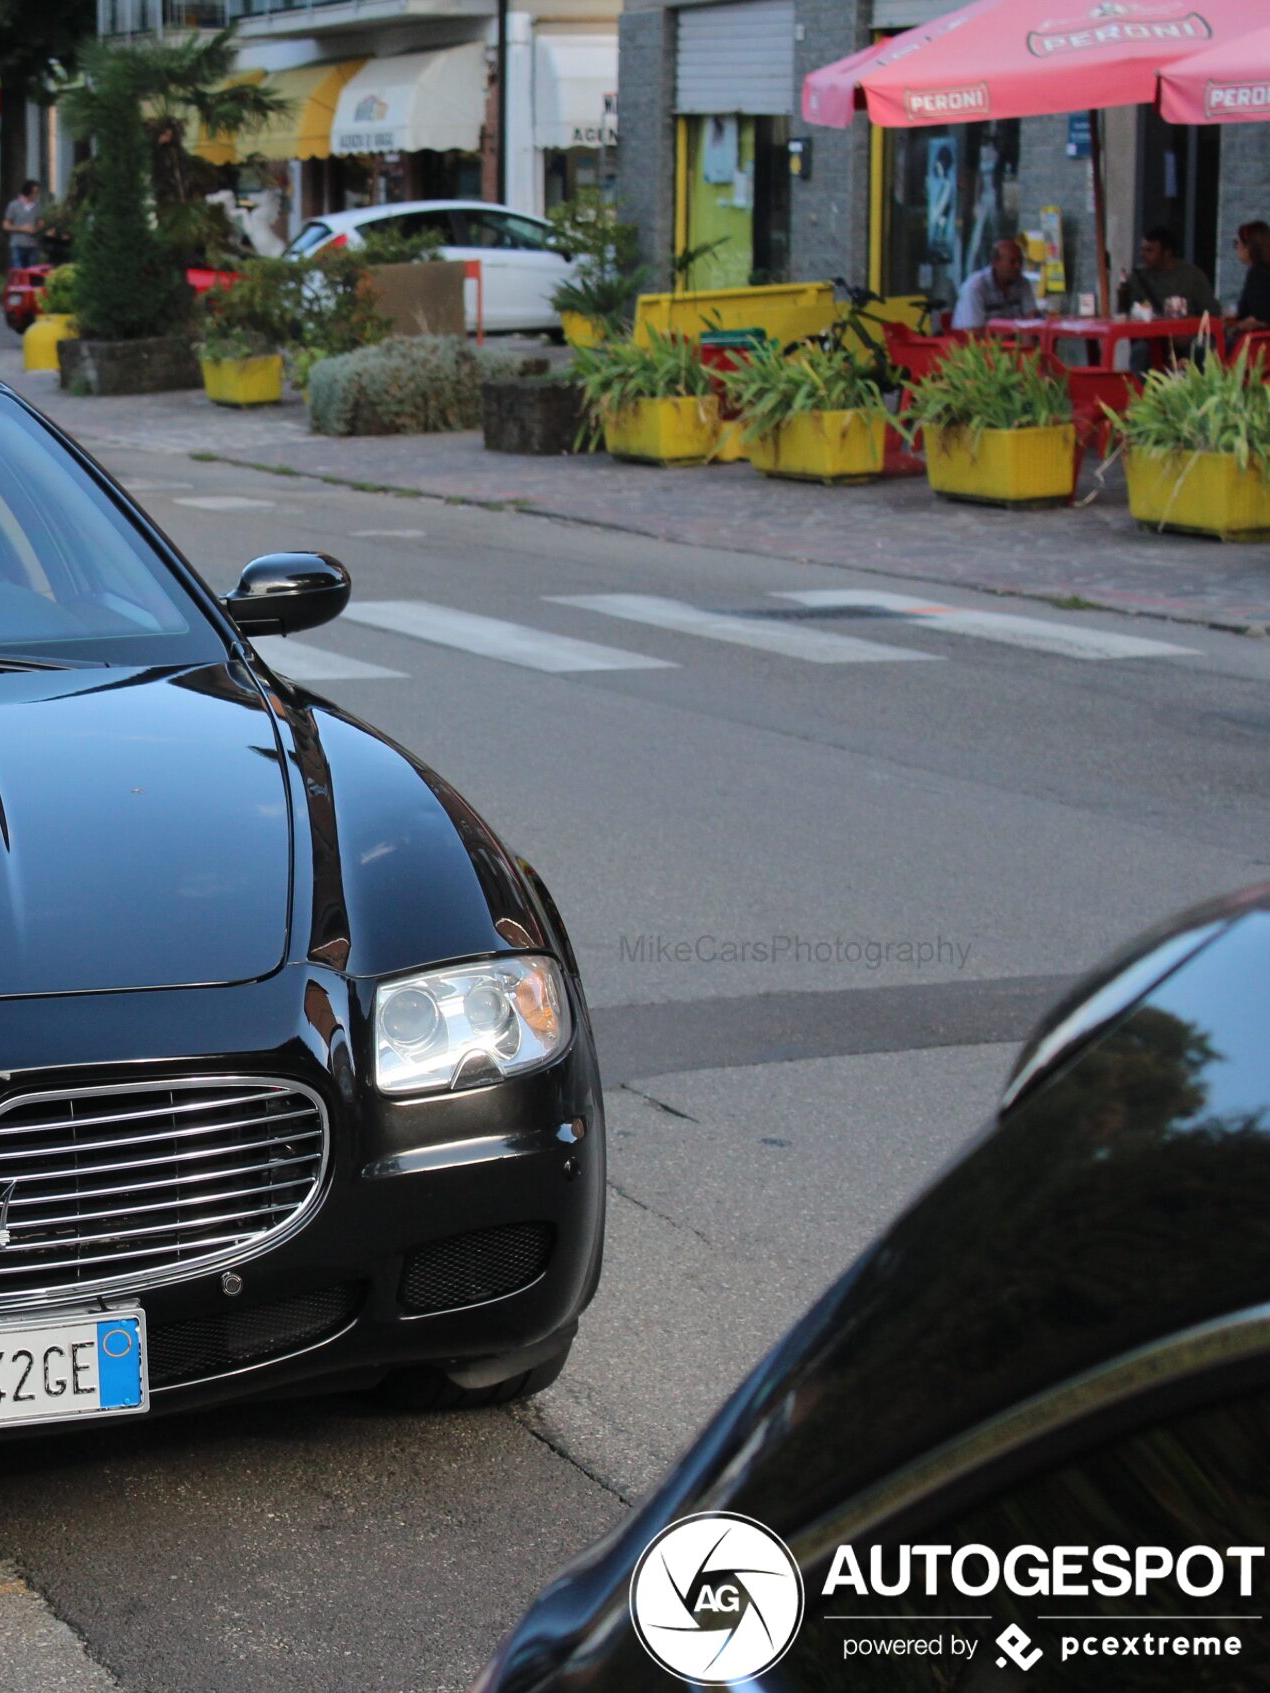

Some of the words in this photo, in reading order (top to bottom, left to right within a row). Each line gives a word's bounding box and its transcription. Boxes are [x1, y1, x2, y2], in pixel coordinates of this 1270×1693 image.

[1042, 22, 1196, 52] PERONI
[911, 90, 984, 113] PERONI
[1210, 86, 1270, 108] PERO
